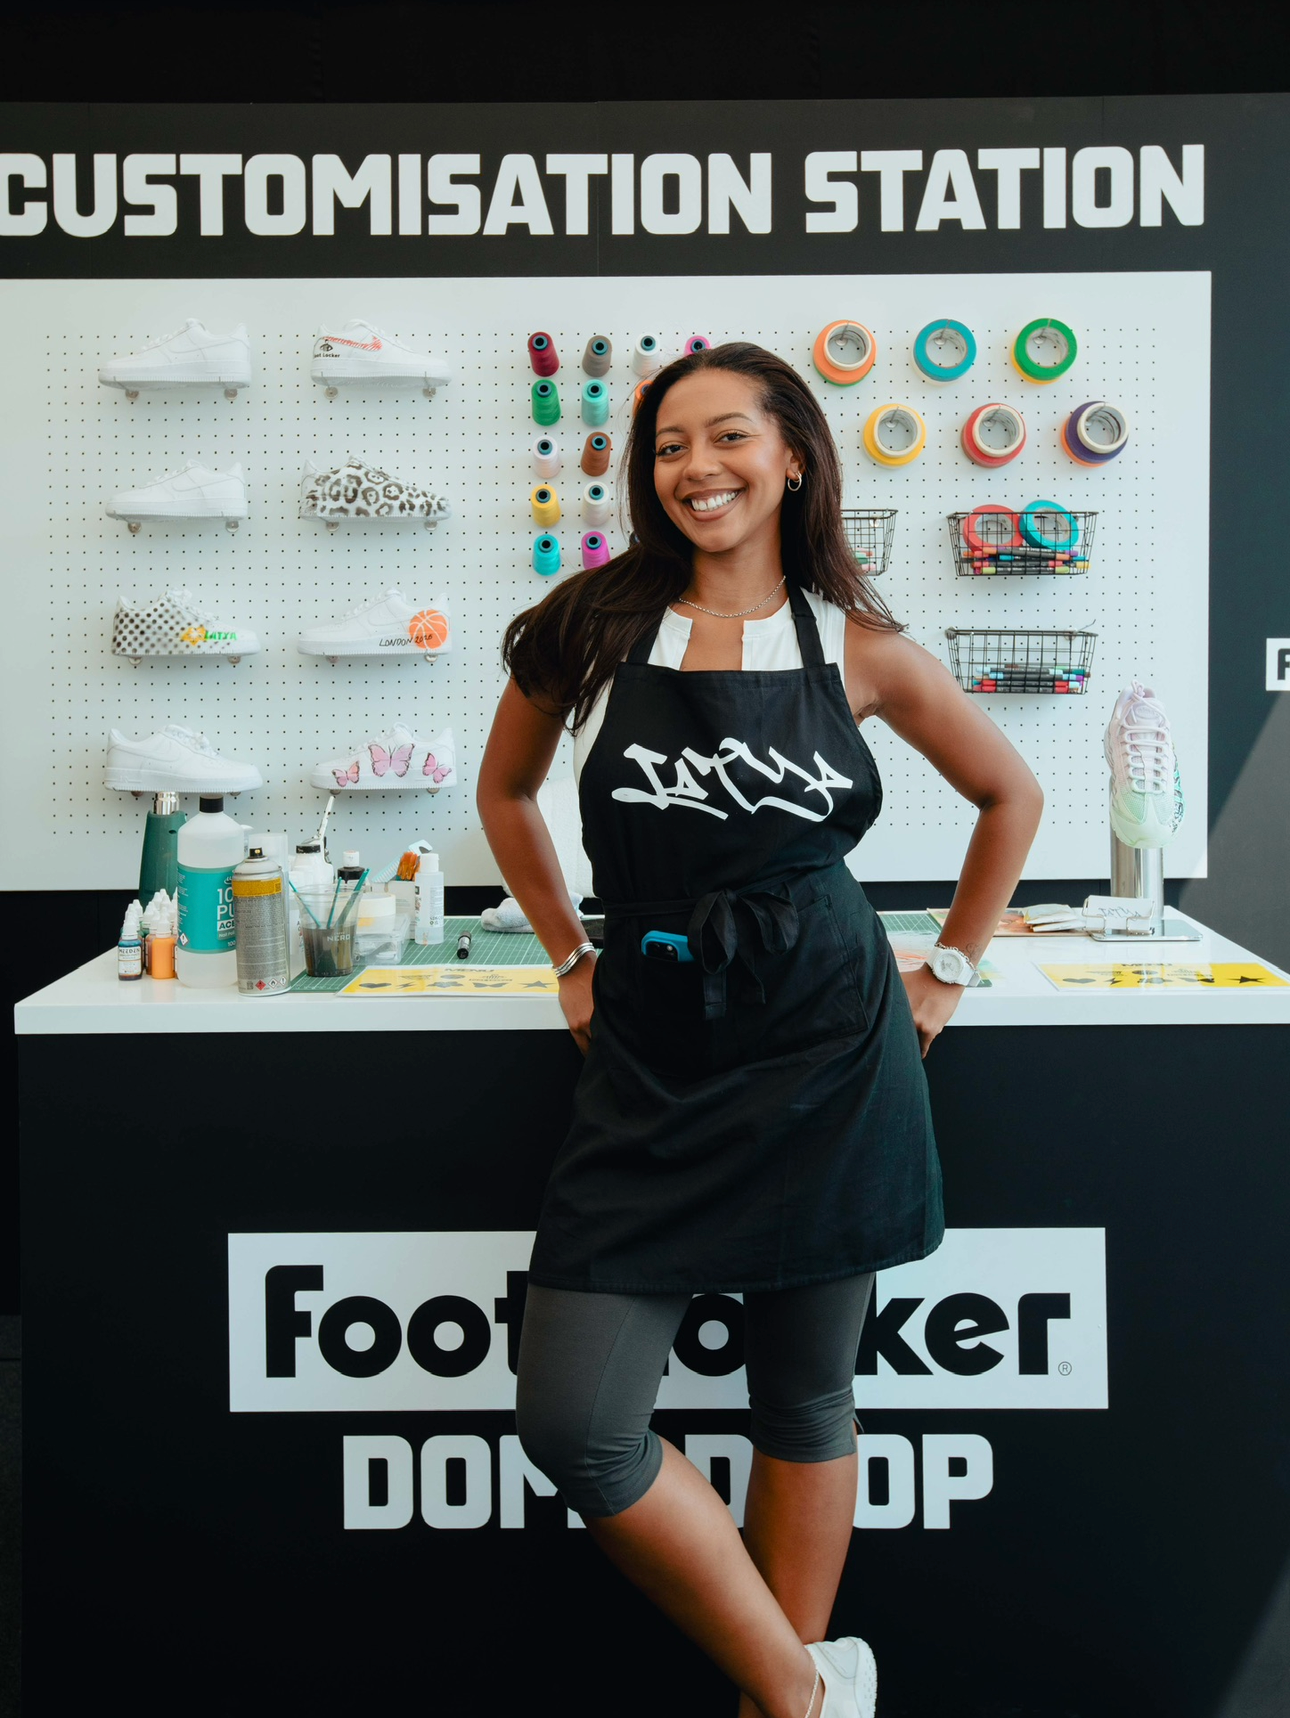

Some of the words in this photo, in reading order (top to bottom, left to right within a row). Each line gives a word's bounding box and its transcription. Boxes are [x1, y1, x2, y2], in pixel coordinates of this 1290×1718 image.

[0, 153, 772, 238] CUSTOMISATION
[804, 144, 1205, 233] STATION
[379, 637, 413, 647] LONDON
[684, 1434, 994, 1530] DOP
